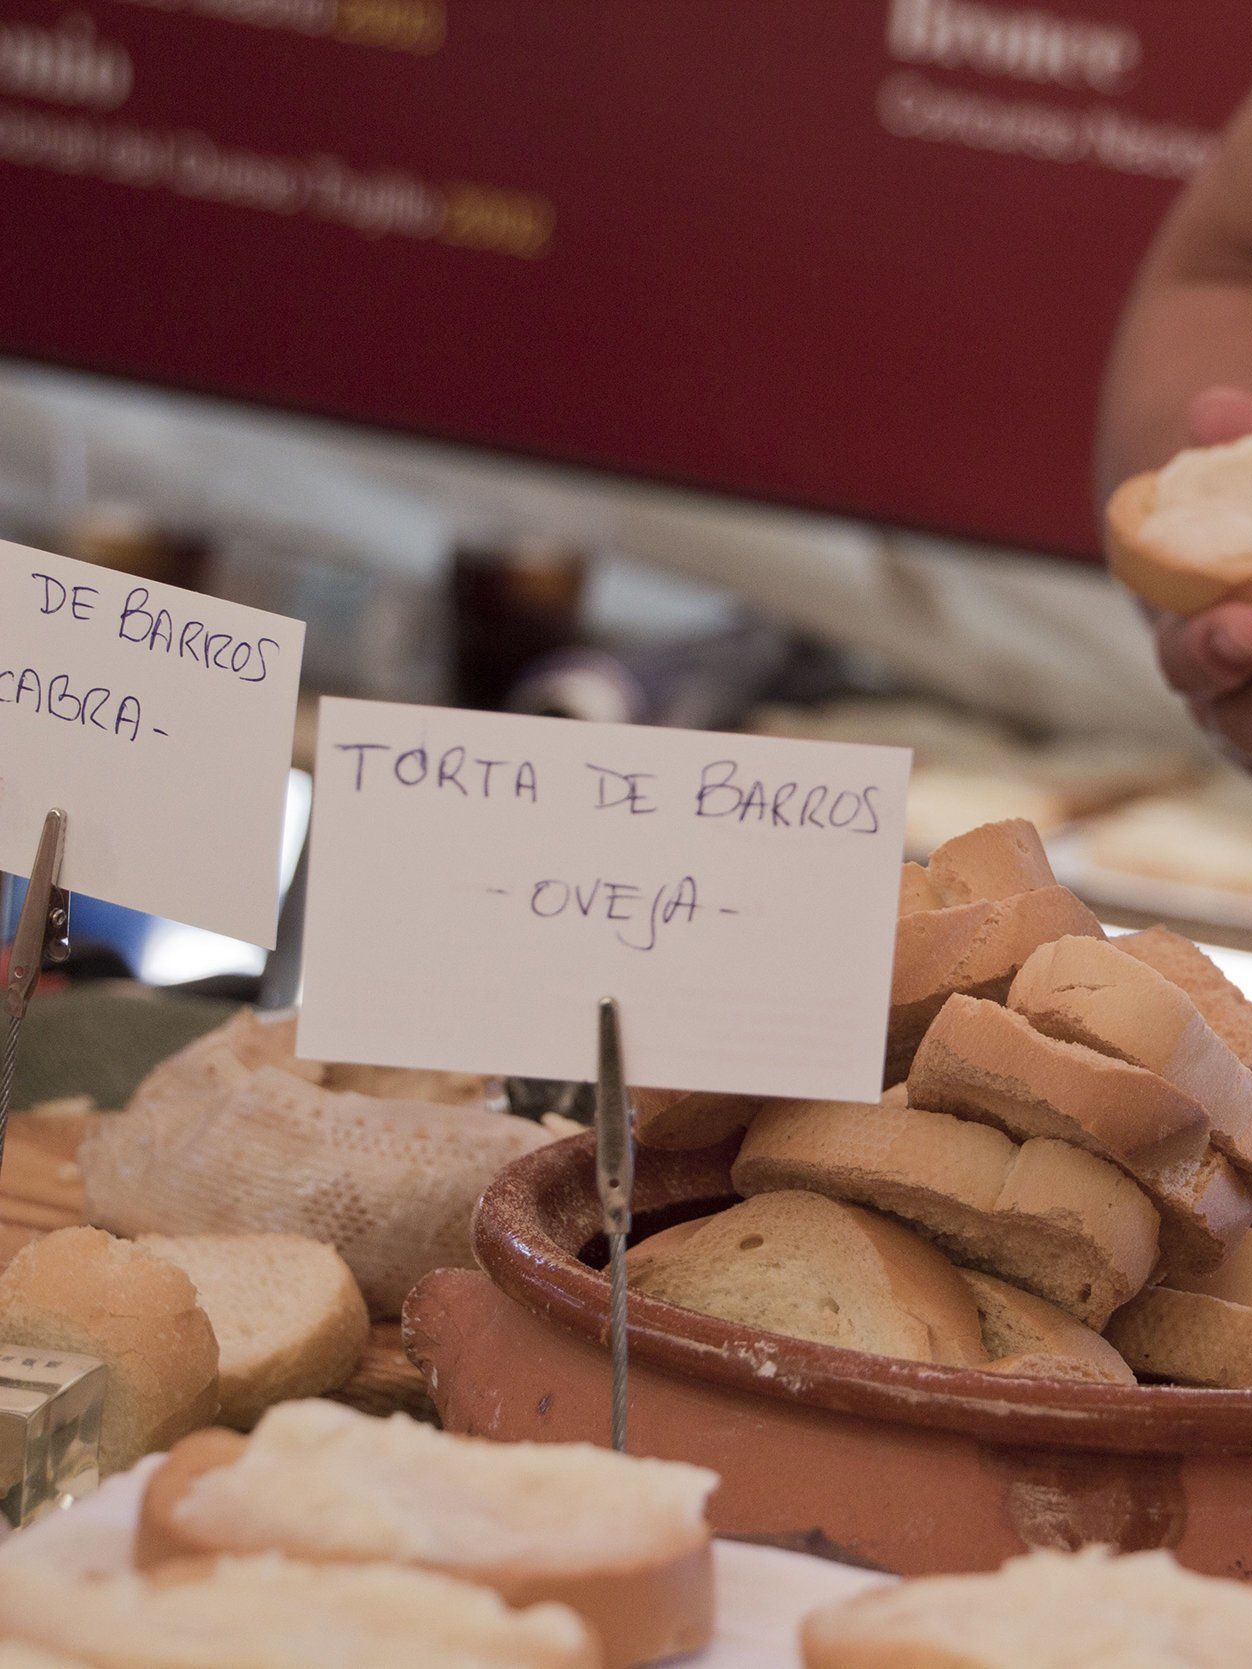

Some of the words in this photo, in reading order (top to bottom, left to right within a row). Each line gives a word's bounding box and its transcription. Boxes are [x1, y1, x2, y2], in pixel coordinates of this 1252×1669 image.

[31, 572, 99, 620] DE
[118, 586, 281, 682] BARROS
[335, 743, 537, 803] TORTA
[586, 763, 657, 814] DE
[696, 760, 879, 834] BARROS
